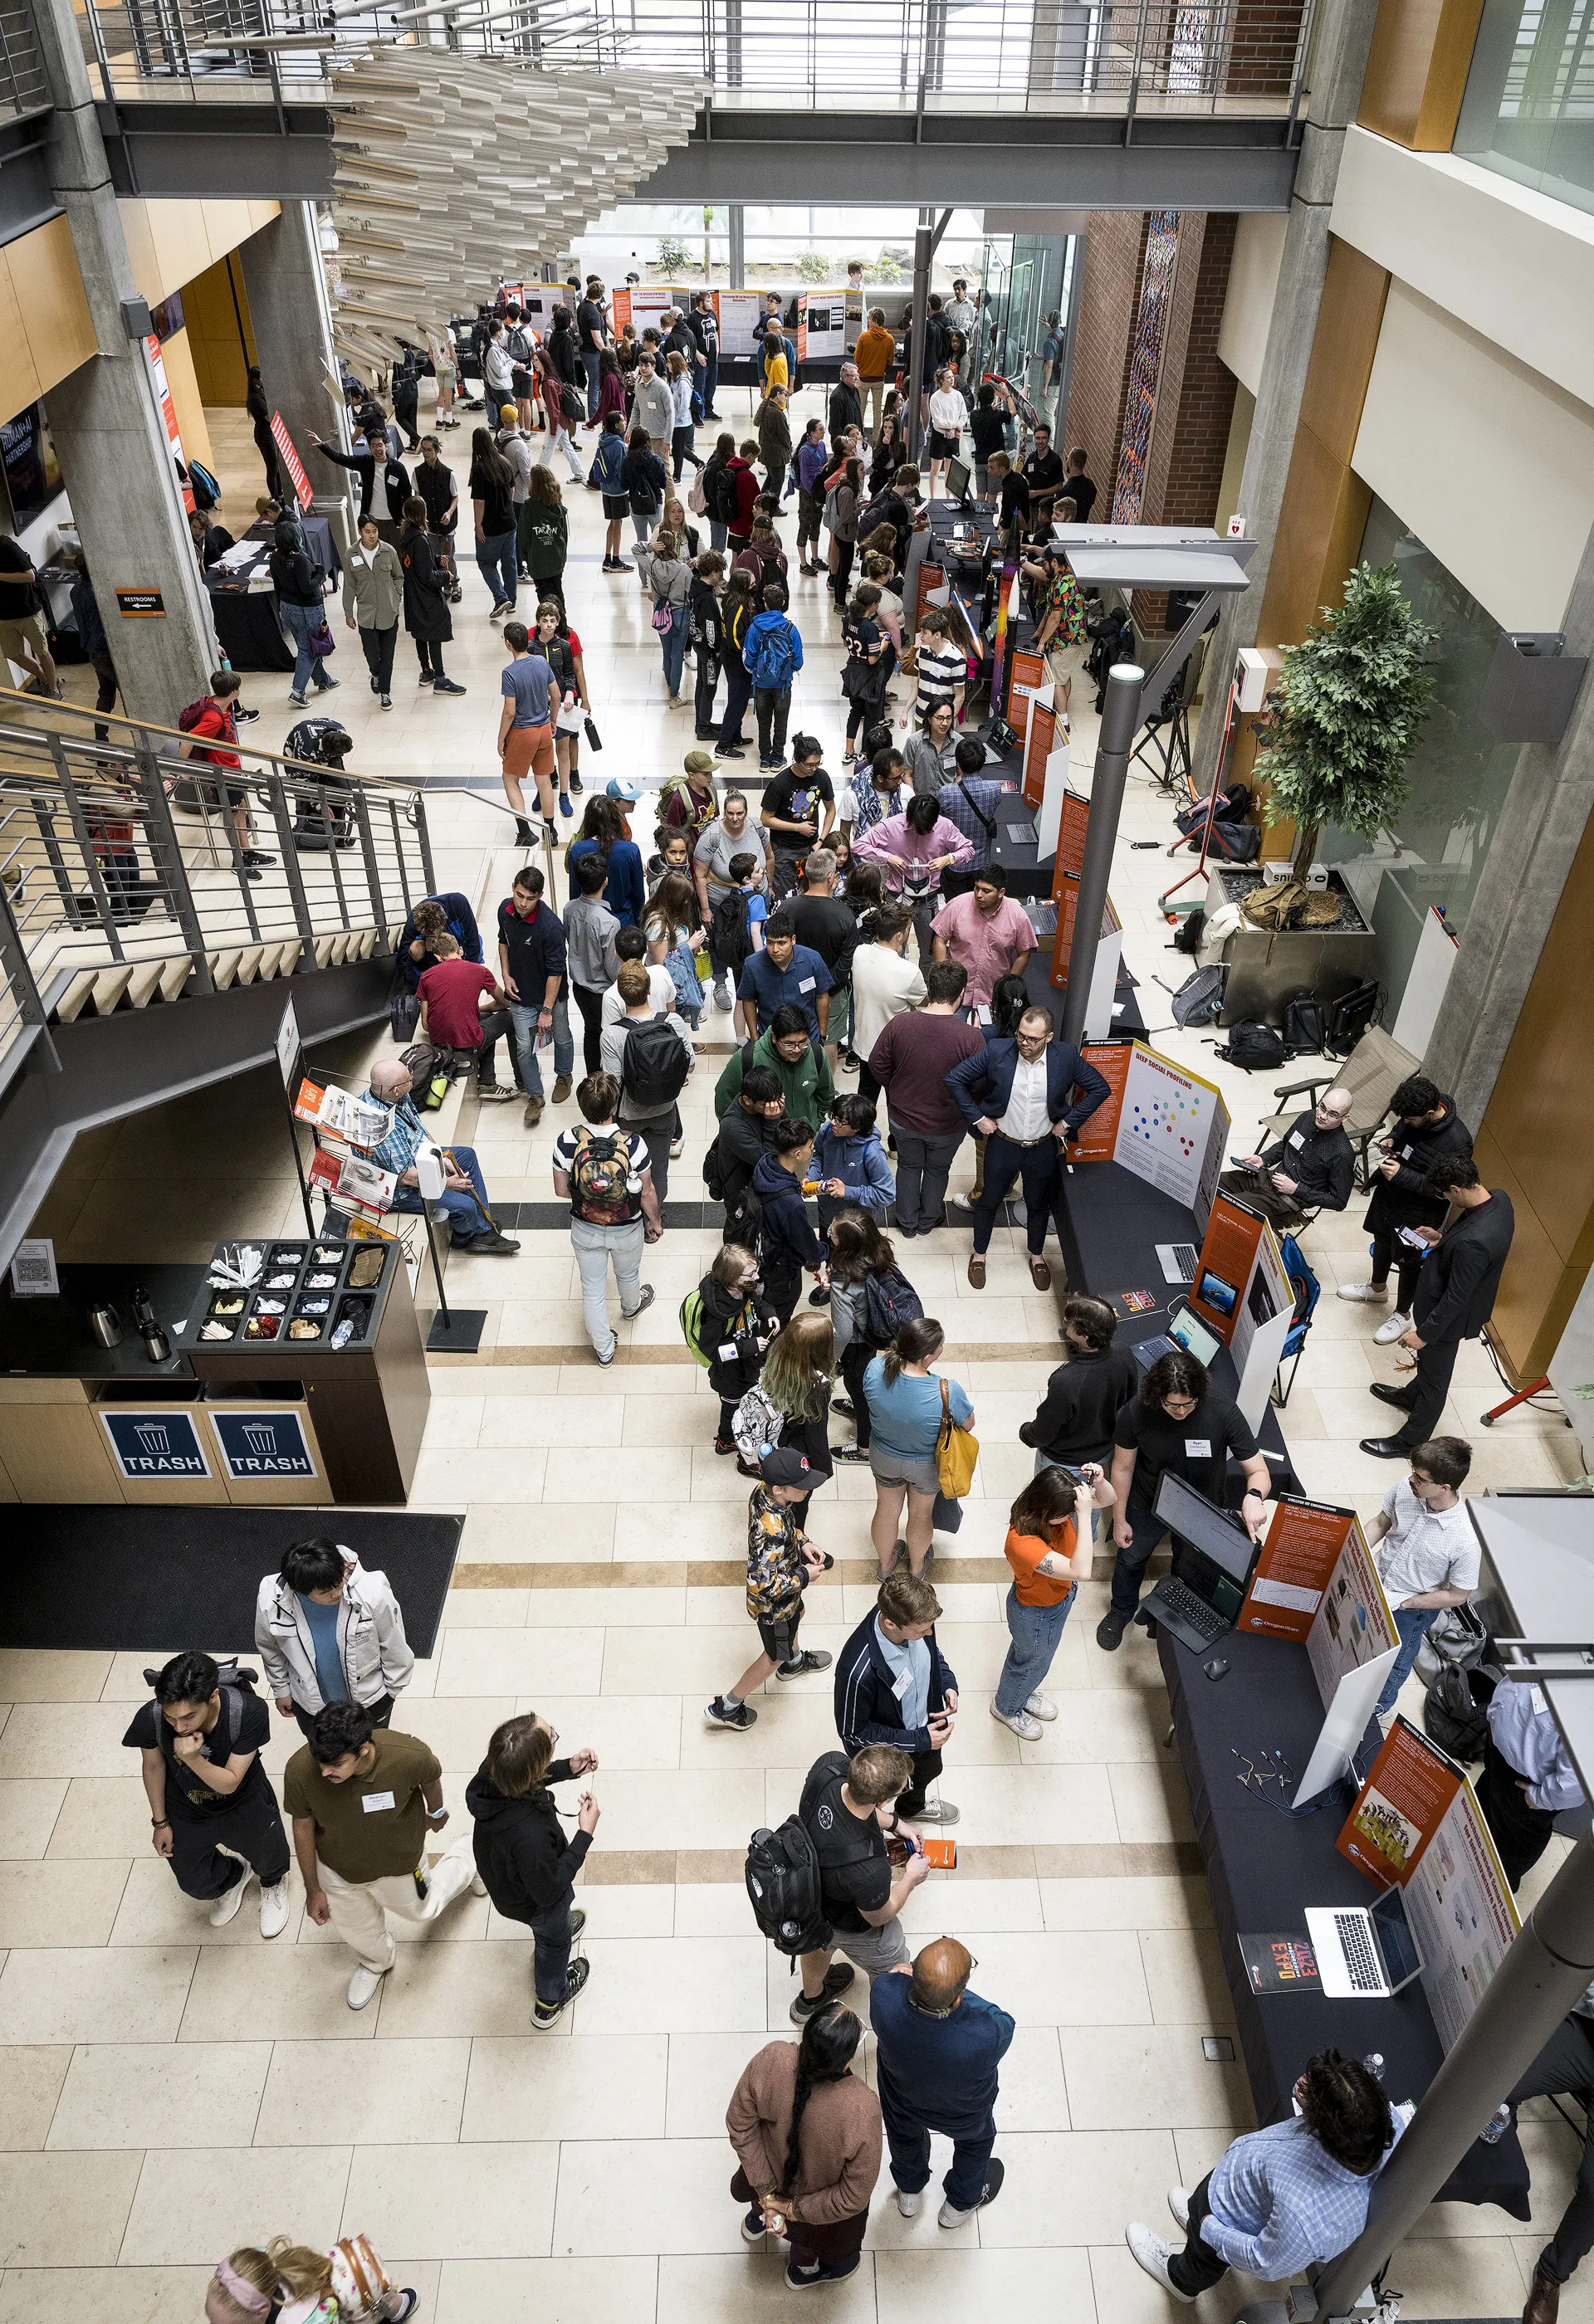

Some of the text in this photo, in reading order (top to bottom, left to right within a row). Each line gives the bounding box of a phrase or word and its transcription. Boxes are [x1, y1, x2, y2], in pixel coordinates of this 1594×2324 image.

[1, 415, 32, 452] HUMAN+AI
[5, 436, 32, 466] PARTNERSHIP
[1274, 874, 1311, 882] olus
[1136, 1052, 1192, 1090] DEEP SOCIAL PROFILING
[1121, 1292, 1142, 1311] EXPO
[125, 1457, 202, 1470] TRASH
[230, 1458, 308, 1471] TRASH
[1284, 1507, 1320, 1518] SKYROCKETING
[1310, 1503, 1337, 1511] ENGINEERING
[1347, 1536, 1381, 1636] In-Home Climate Control
[1351, 1529, 1361, 1560] Sensor
[1359, 1556, 1371, 1587] System
[1375, 1600, 1391, 1650] Self-Driven
[1264, 1621, 1284, 1629] Oregon
[1395, 1738, 1416, 1759] INDUSTRY
[1396, 1735, 1430, 1766] CONSTRUCTION
[1399, 1729, 1411, 1741] NEW
[1421, 1750, 1445, 1772] PLATFORM
[1403, 1721, 1419, 1737] COLLEGE
[1423, 1740, 1448, 1764] ENGINEERING
[1416, 1750, 1425, 1759] THE
[1360, 1854, 1391, 1887] Oregon State
[1461, 1796, 1513, 1942] Blockchain-based Smart Contra
[1469, 1837, 1494, 1903] Infrastructure
[1493, 1904, 1507, 1944] Funding
[1271, 1943, 1296, 1979] EXPO
[1293, 1942, 1318, 1976] 2023
